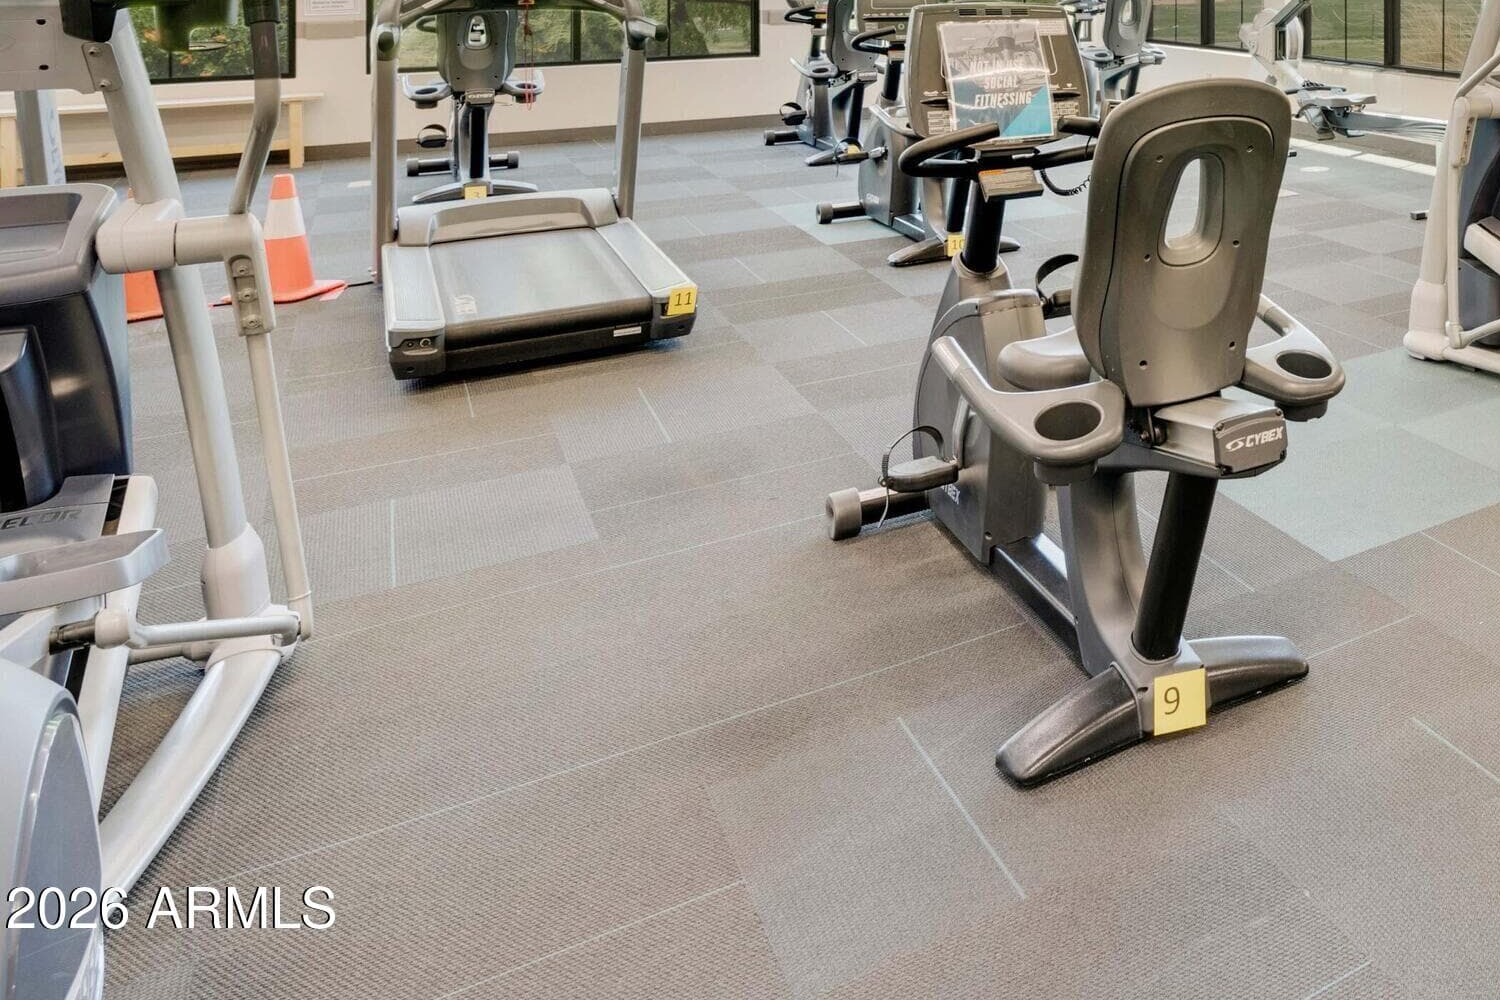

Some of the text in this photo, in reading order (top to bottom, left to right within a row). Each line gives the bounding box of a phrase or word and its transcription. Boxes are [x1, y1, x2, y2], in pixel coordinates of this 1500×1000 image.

[983, 75, 1019, 90] SOCIAL
[974, 91, 1032, 108] FITNESSING
[674, 291, 693, 307] 11
[1245, 426, 1284, 448] CYBEX
[1164, 686, 1180, 715] 9
